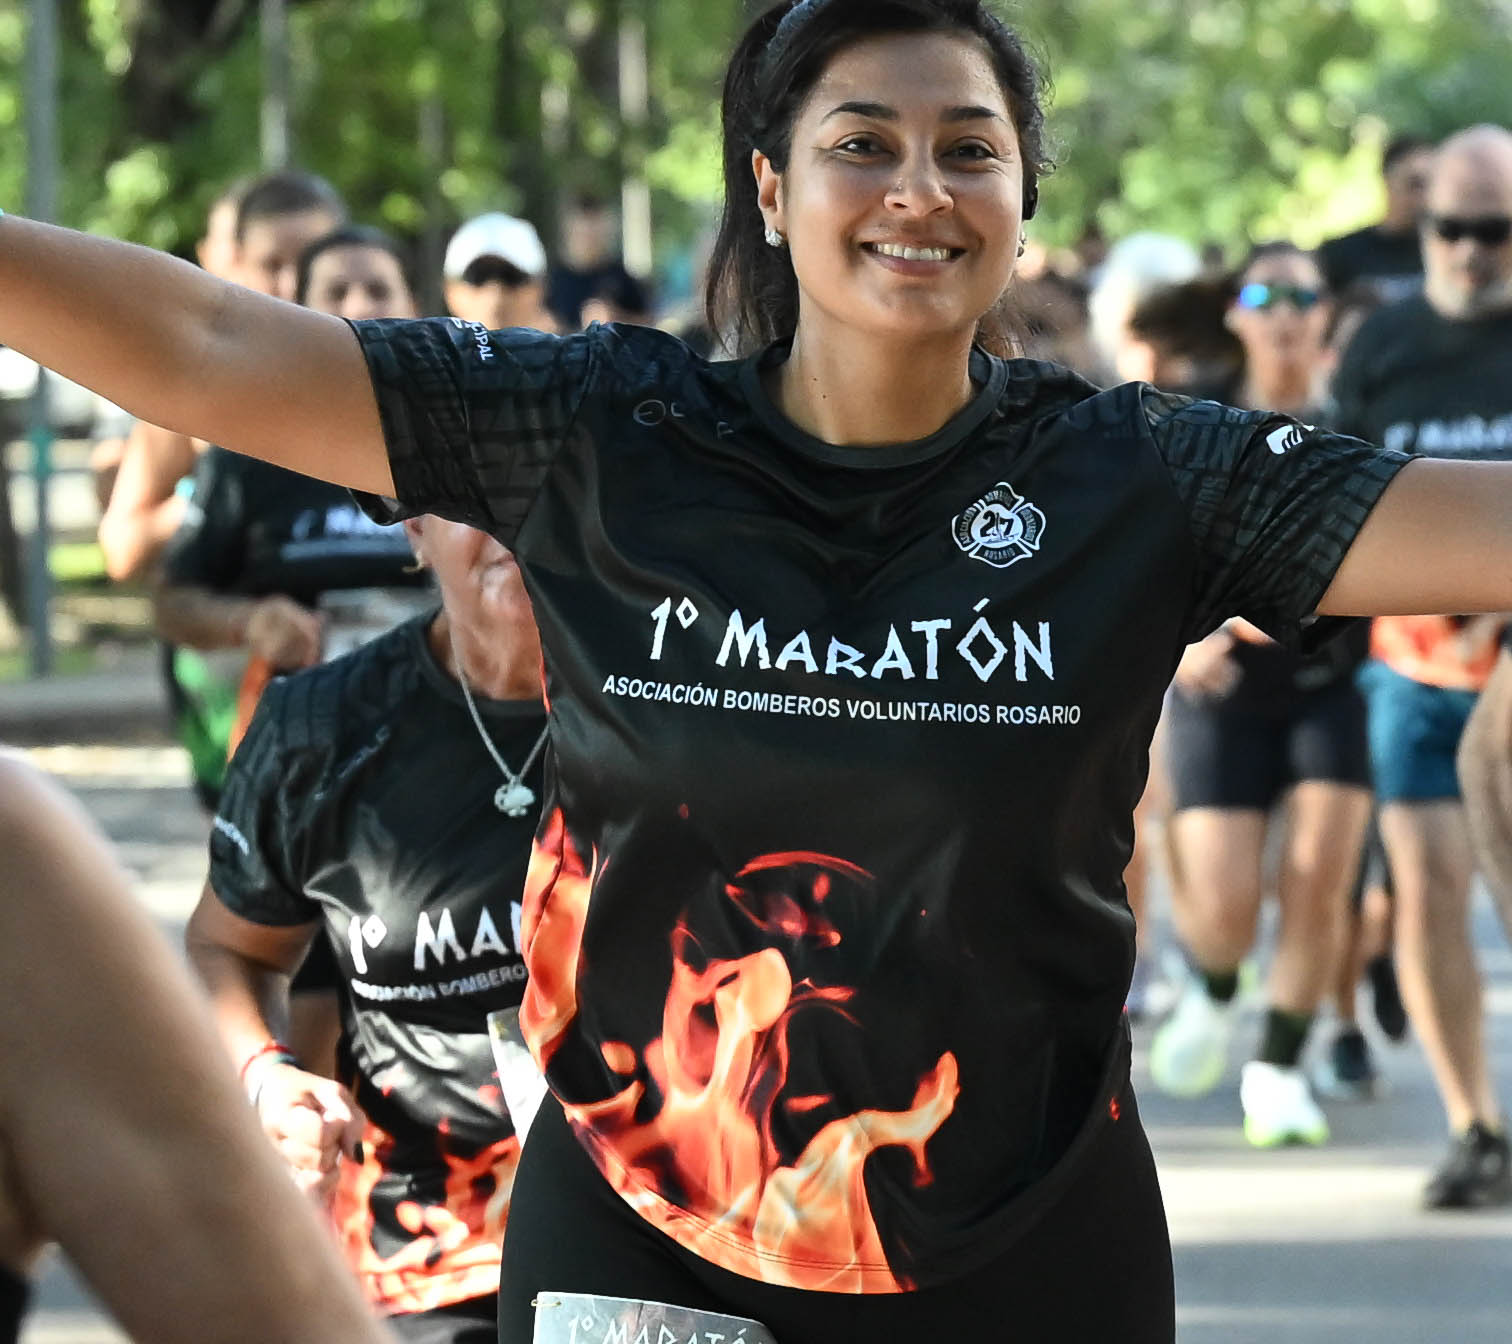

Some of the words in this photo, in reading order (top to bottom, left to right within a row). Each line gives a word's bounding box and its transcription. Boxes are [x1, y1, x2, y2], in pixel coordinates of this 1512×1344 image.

[979, 509, 1015, 538] 27
[715, 598, 1055, 683] MARATÓN
[601, 673, 719, 708] ASOCIACIÓN
[723, 688, 841, 719] BOMBEROS
[846, 699, 991, 725] VOLUNTARIOS
[995, 704, 1081, 726] ROSARIO
